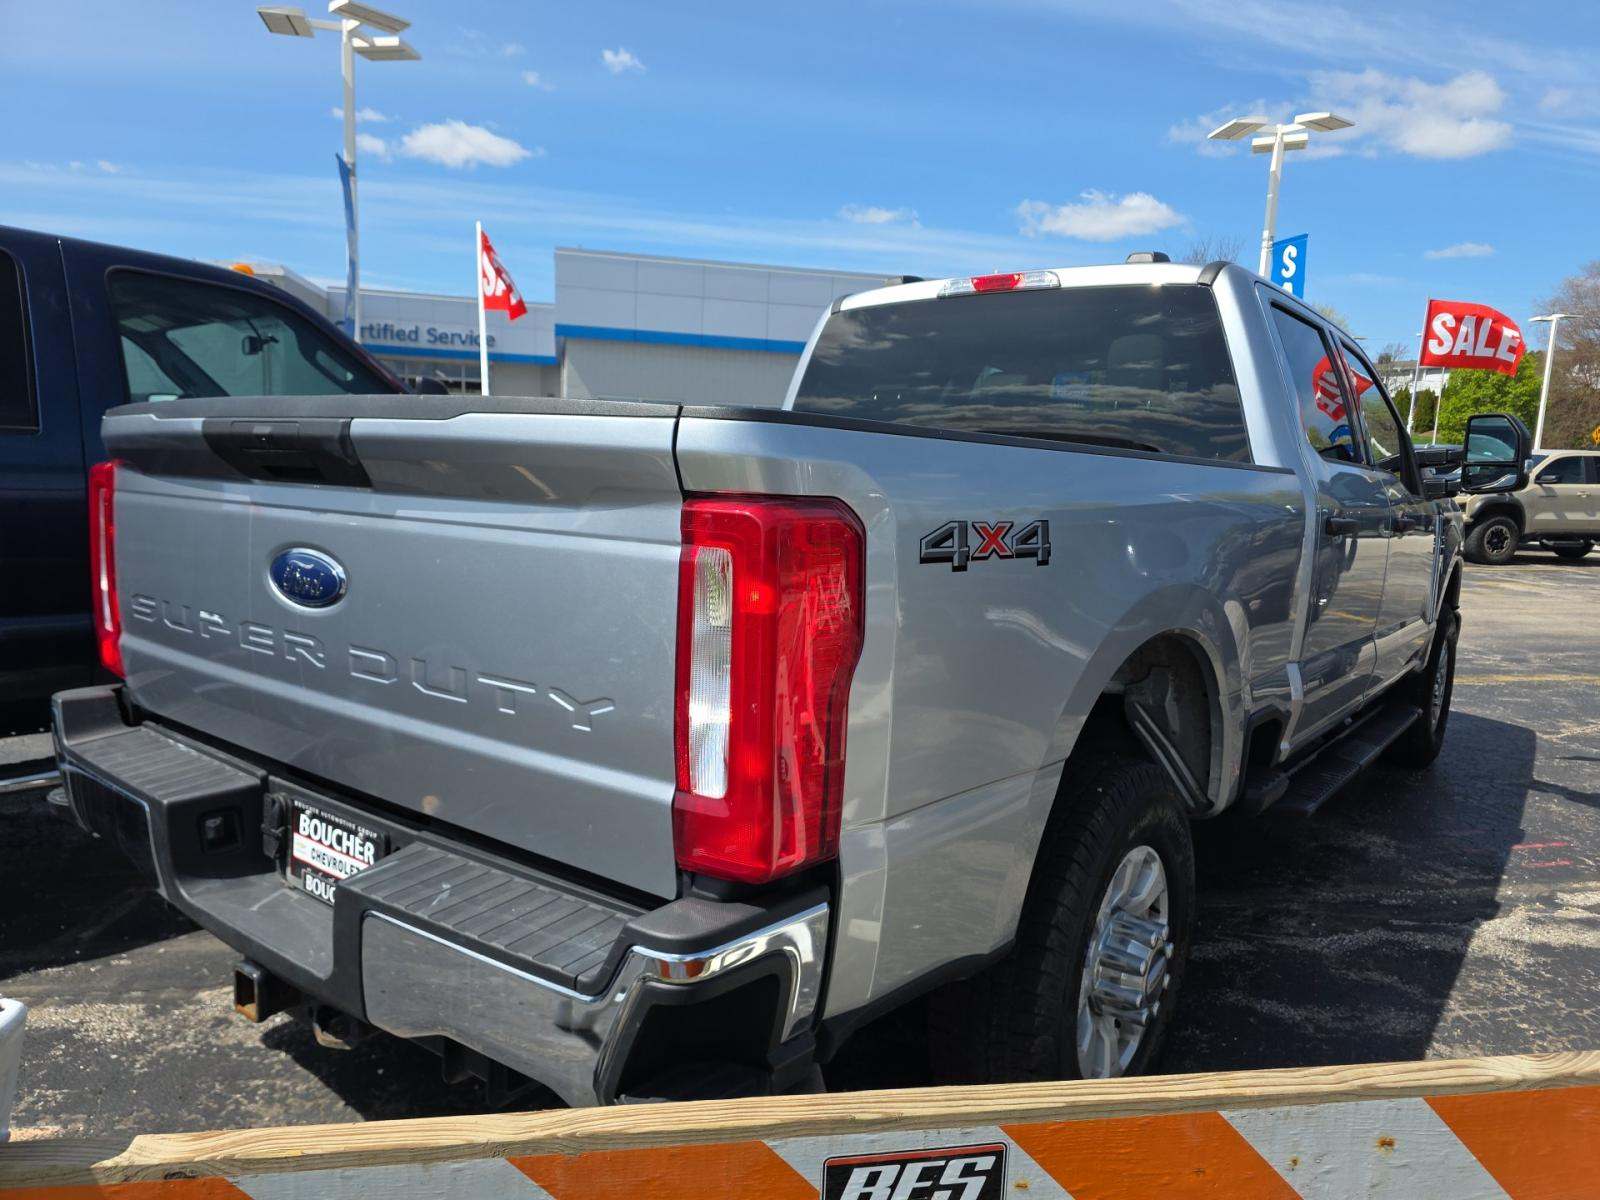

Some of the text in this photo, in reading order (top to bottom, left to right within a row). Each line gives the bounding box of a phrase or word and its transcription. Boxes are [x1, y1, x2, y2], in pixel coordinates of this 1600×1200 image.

[335, 319, 419, 342] rtified
[1428, 312, 1520, 362] SALE
[132, 593, 615, 732] SUPER DUTY
[299, 813, 375, 865] BOUCHER
